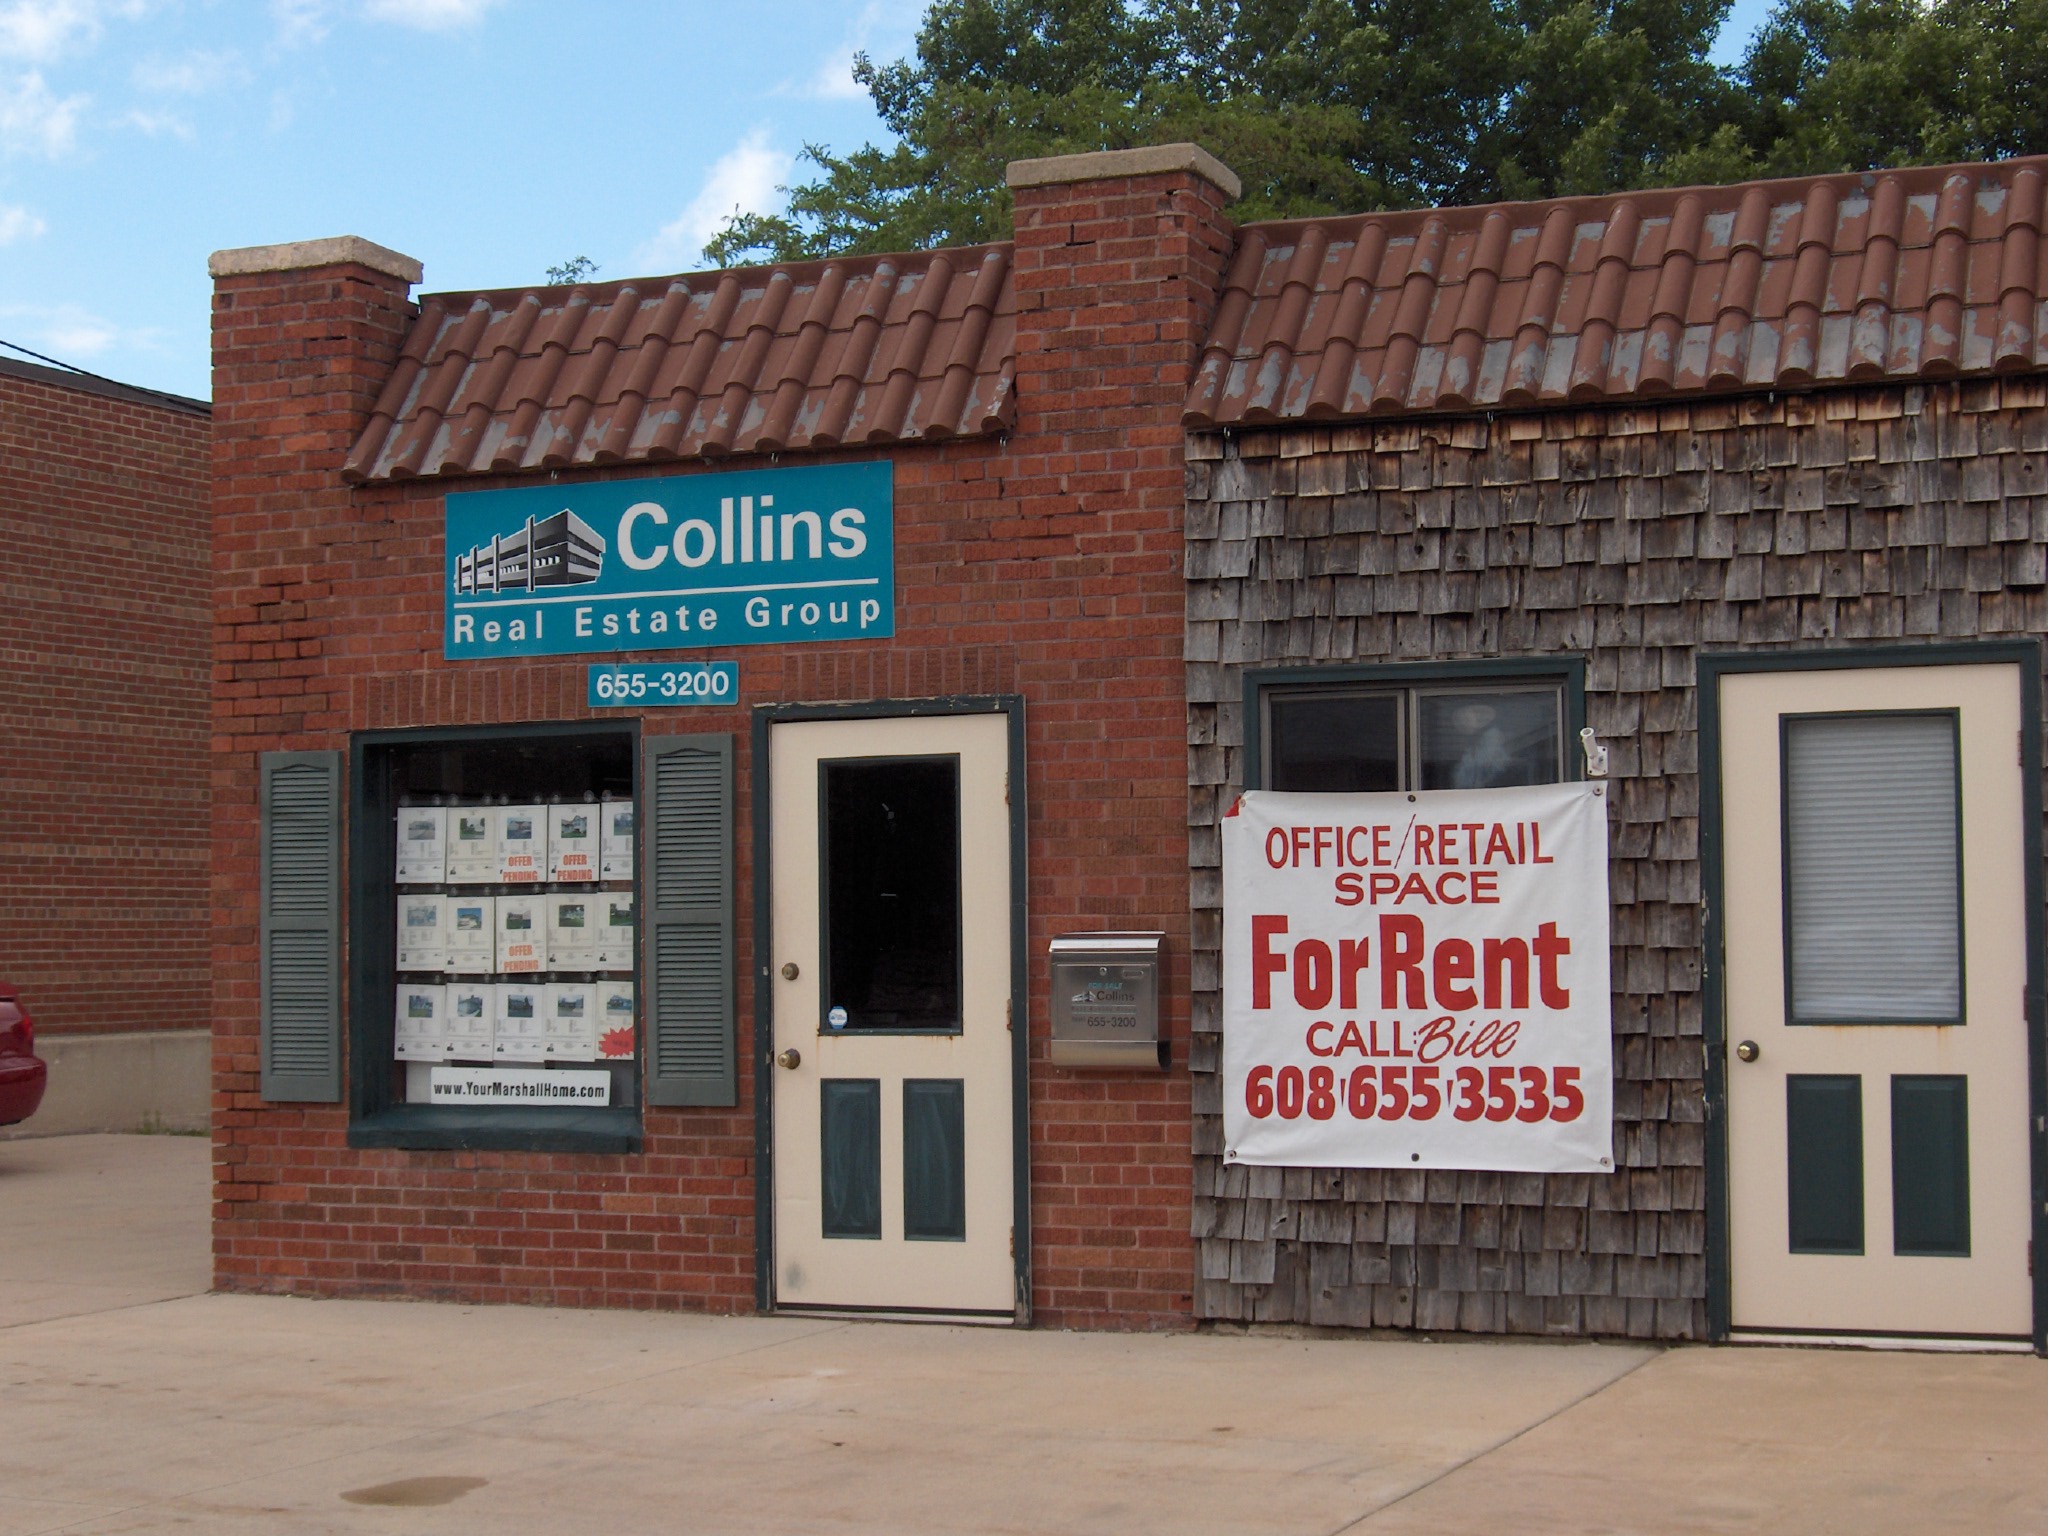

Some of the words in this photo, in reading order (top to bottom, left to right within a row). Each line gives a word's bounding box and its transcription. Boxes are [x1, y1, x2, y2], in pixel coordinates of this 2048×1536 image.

[616, 493, 868, 571] Collins
[454, 610, 544, 644] Real
[575, 606, 719, 637] Estate
[744, 596, 881, 629] Group
[596, 670, 730, 699] 655-3200
[508, 855, 533, 867] OFFER
[562, 854, 588, 866] OFFER
[502, 870, 539, 882] PENDING
[556, 869, 593, 881] PENDING
[1334, 871, 1501, 905] SPACE
[508, 945, 533, 957] OFFER
[503, 960, 539, 972] PENDING
[1096, 990, 1135, 1002] Collins
[1087, 1016, 1137, 1028] 655-3200
[434, 1081, 605, 1098] www.YourMarshallHome.com
